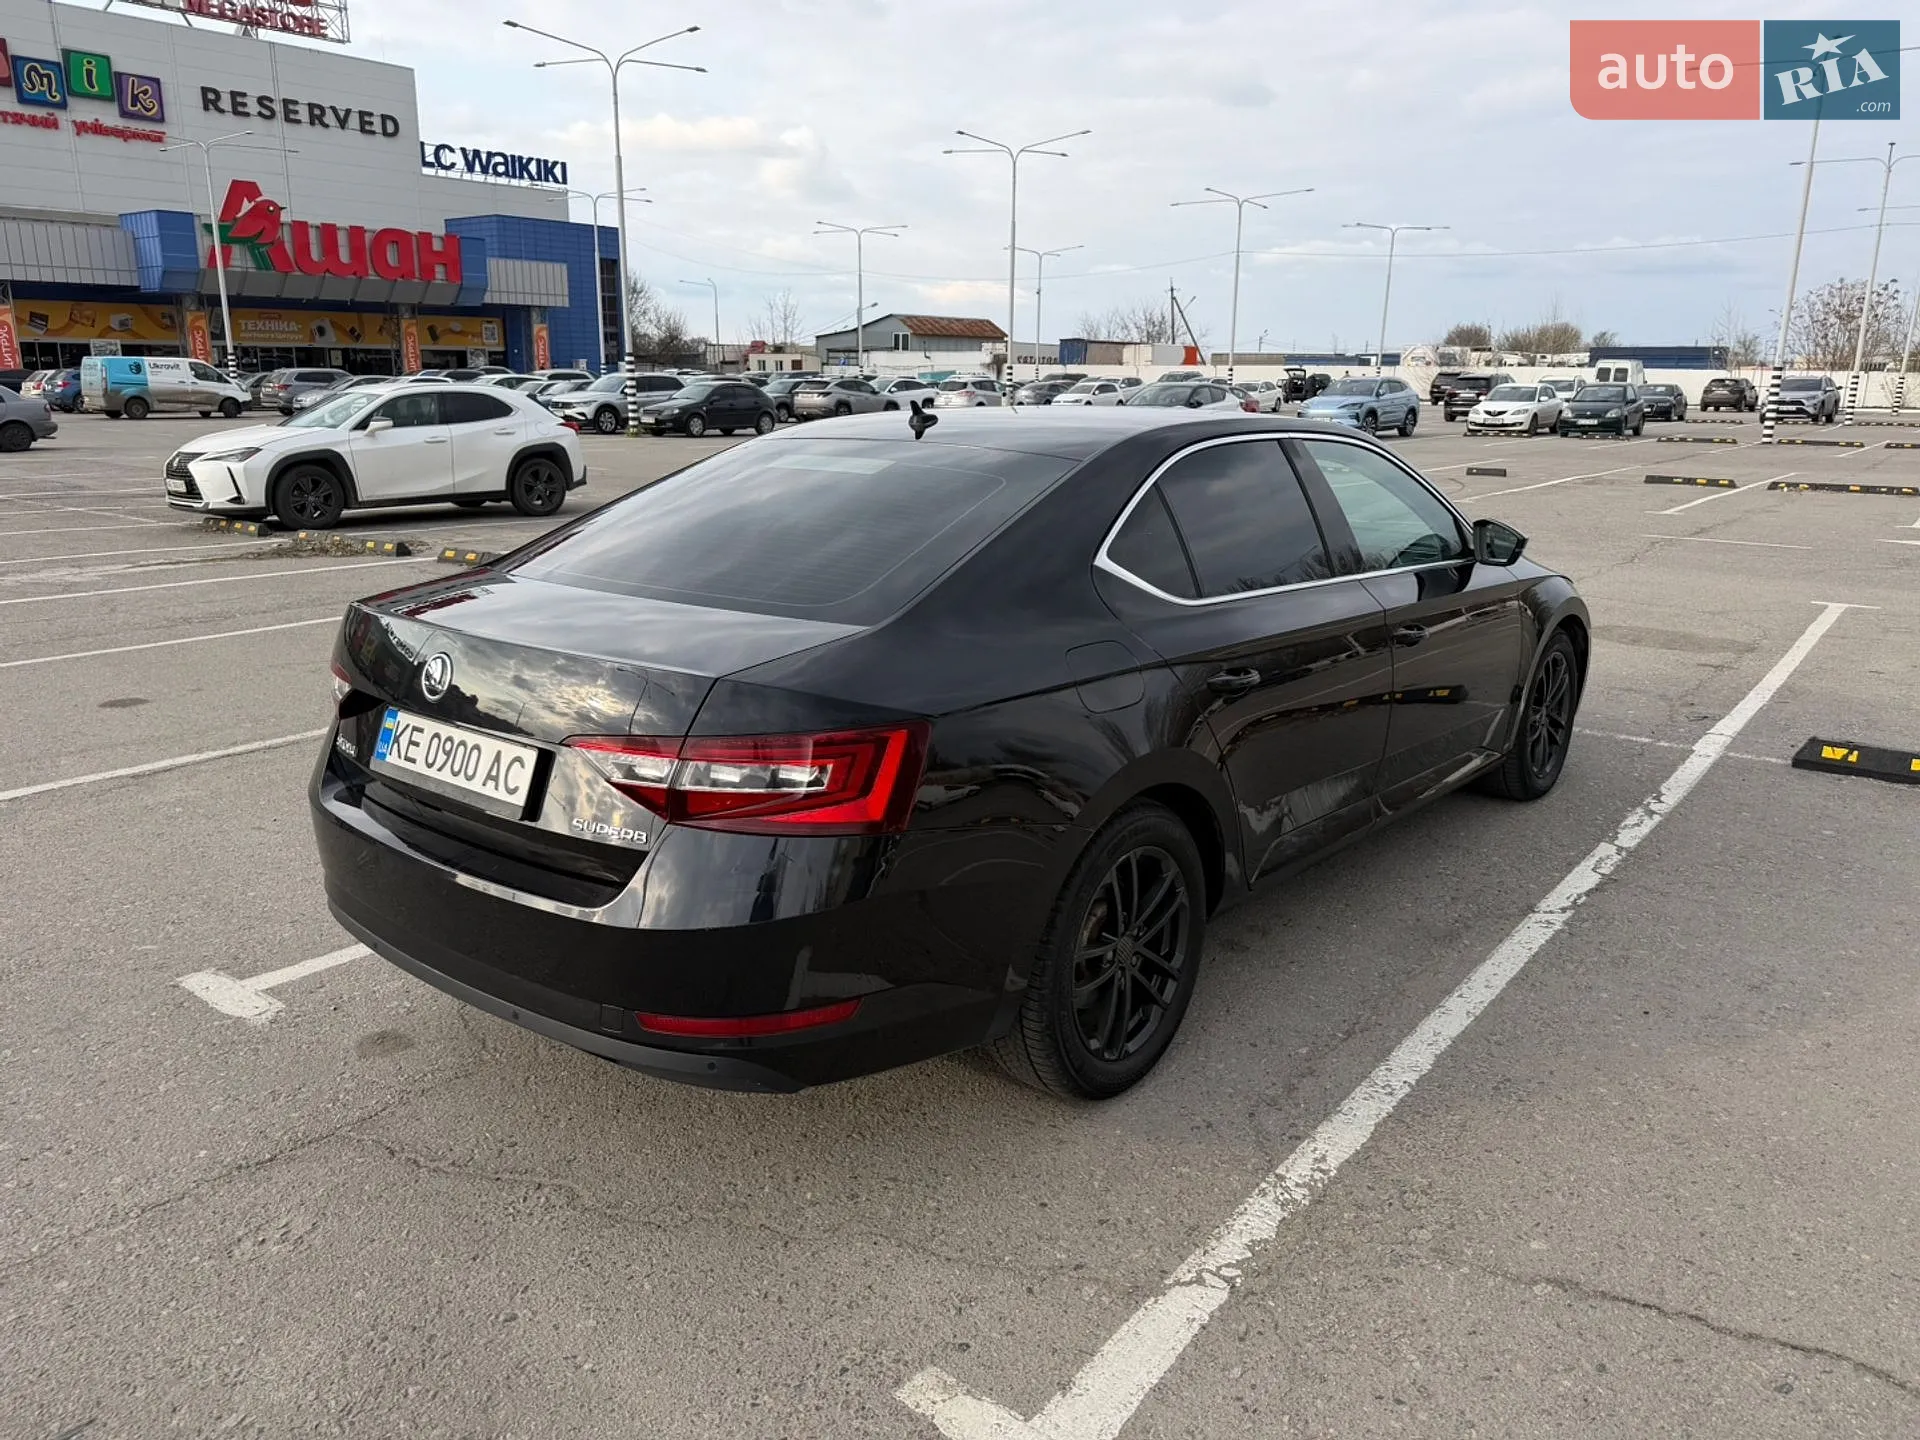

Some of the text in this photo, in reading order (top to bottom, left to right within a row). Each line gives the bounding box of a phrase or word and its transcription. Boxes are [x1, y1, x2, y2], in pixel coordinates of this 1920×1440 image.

[200, 85, 401, 138] RESERVED
[420, 141, 457, 171] LC
[389, 720, 526, 796] KE 0900 AC
[572, 817, 648, 844] SUPERB
